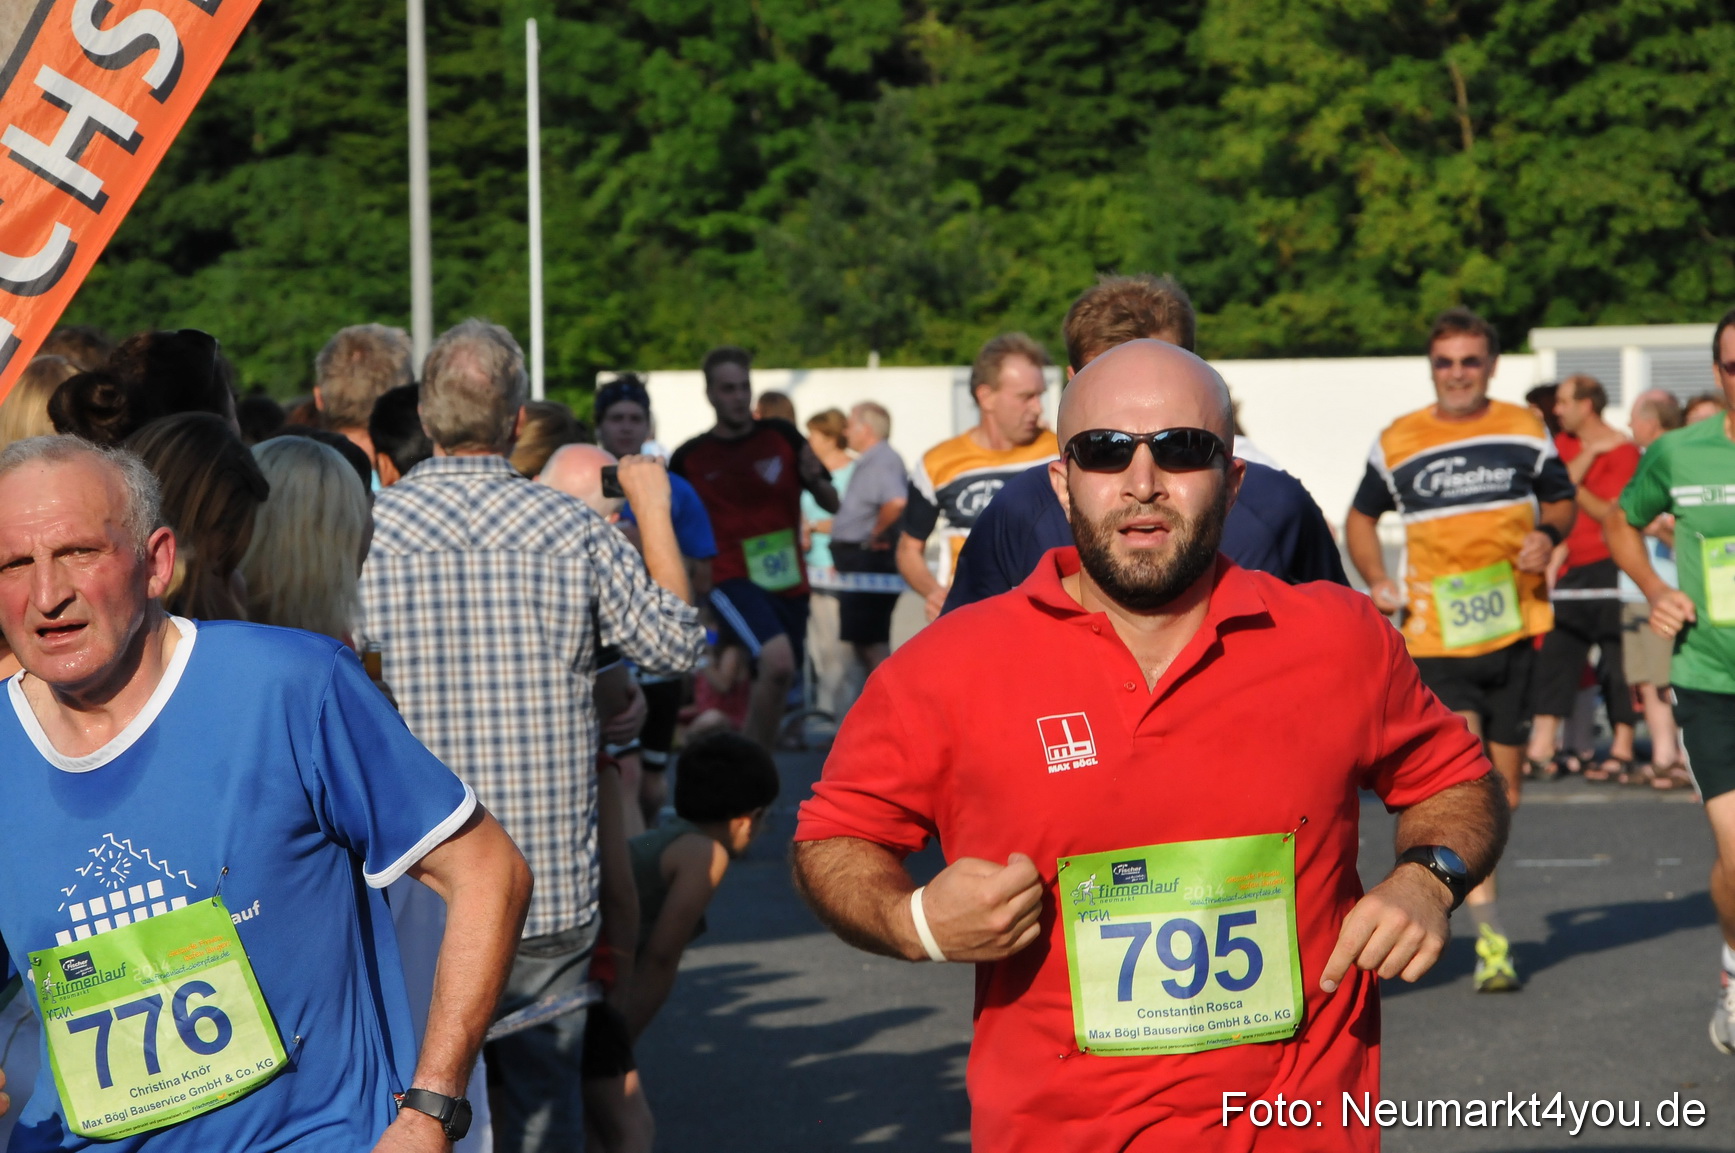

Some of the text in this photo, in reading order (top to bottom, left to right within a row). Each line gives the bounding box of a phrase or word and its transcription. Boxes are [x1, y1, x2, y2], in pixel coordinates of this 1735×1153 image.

[1413, 456, 1516, 496] Fischer
[1450, 589, 1505, 628] 380
[1047, 757, 1099, 774] MAX BÖGL
[1098, 877, 1180, 899] firmenlauf
[1099, 896, 1135, 904] neumarkt
[1184, 884, 1225, 901] 2014
[132, 959, 171, 982] 2014
[1100, 910, 1264, 1002] 795
[54, 962, 127, 997] firmenlauf
[59, 989, 90, 1001] neumarkt
[1088, 1008, 1291, 1039] Max Bögl Bauservice GmbH & Co. KG
[1137, 1000, 1243, 1019] Constantin Rosca
[66, 980, 233, 1090] 776
[82, 1117, 103, 1130] Max
[105, 1106, 129, 1124] Bögl
[131, 1092, 187, 1116] Bauservice
[188, 1077, 223, 1098] GmbH
[225, 1073, 234, 1083] &
[235, 1067, 255, 1079] Co.
[256, 1057, 275, 1071] KG
[129, 1064, 212, 1099] Christina Knör
